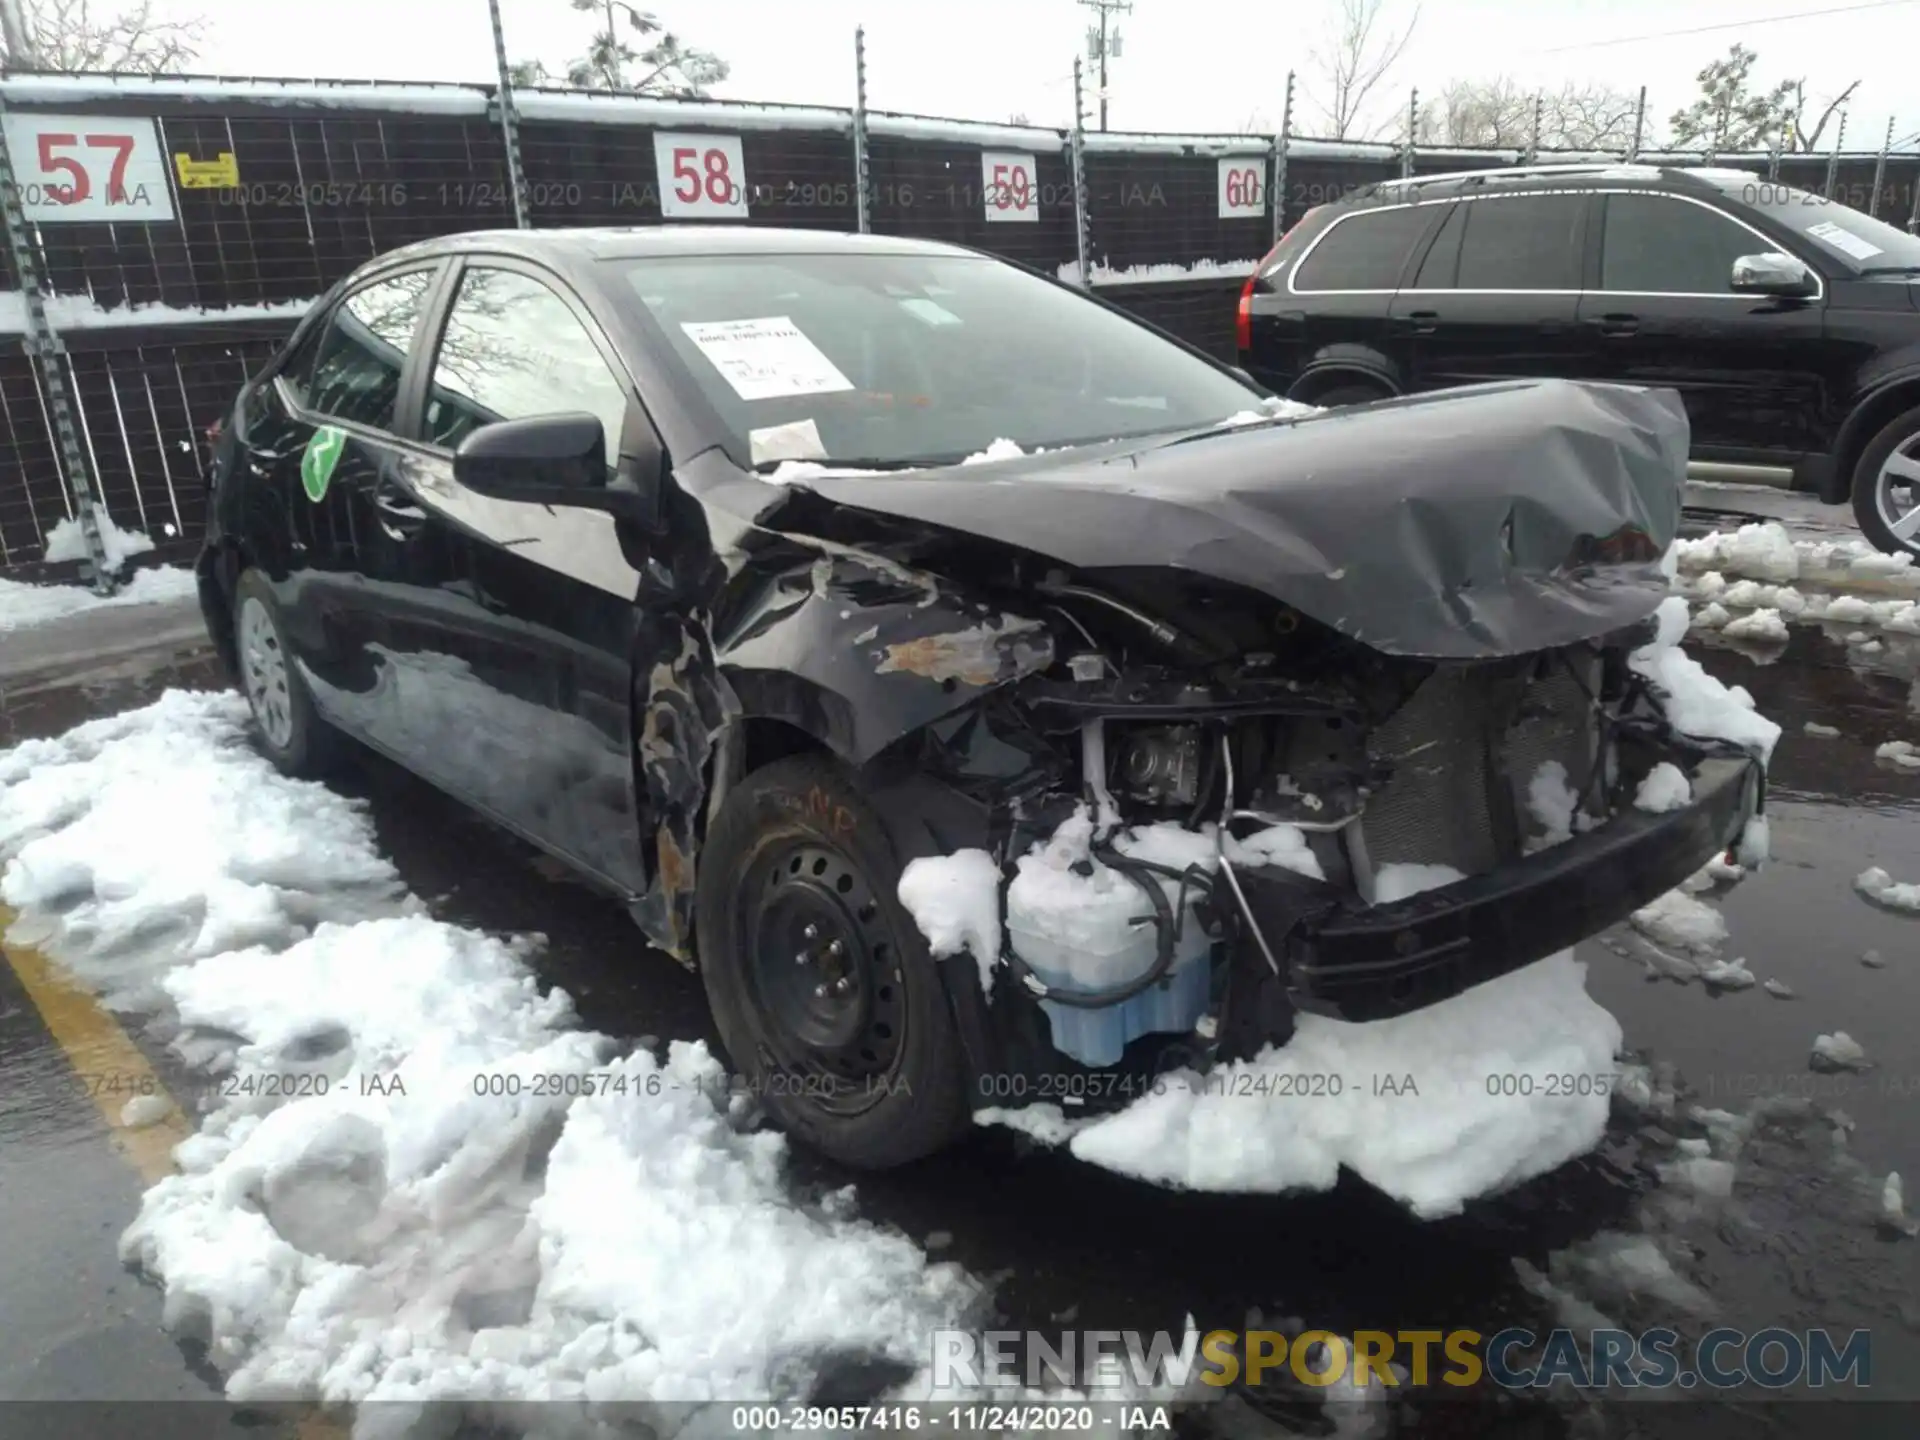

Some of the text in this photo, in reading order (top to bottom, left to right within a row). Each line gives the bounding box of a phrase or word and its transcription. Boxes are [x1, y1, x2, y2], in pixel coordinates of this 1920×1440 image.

[37, 133, 135, 206] 57
[672, 147, 733, 205] 58
[993, 165, 1030, 211] 59
[1225, 168, 1258, 208] 60
